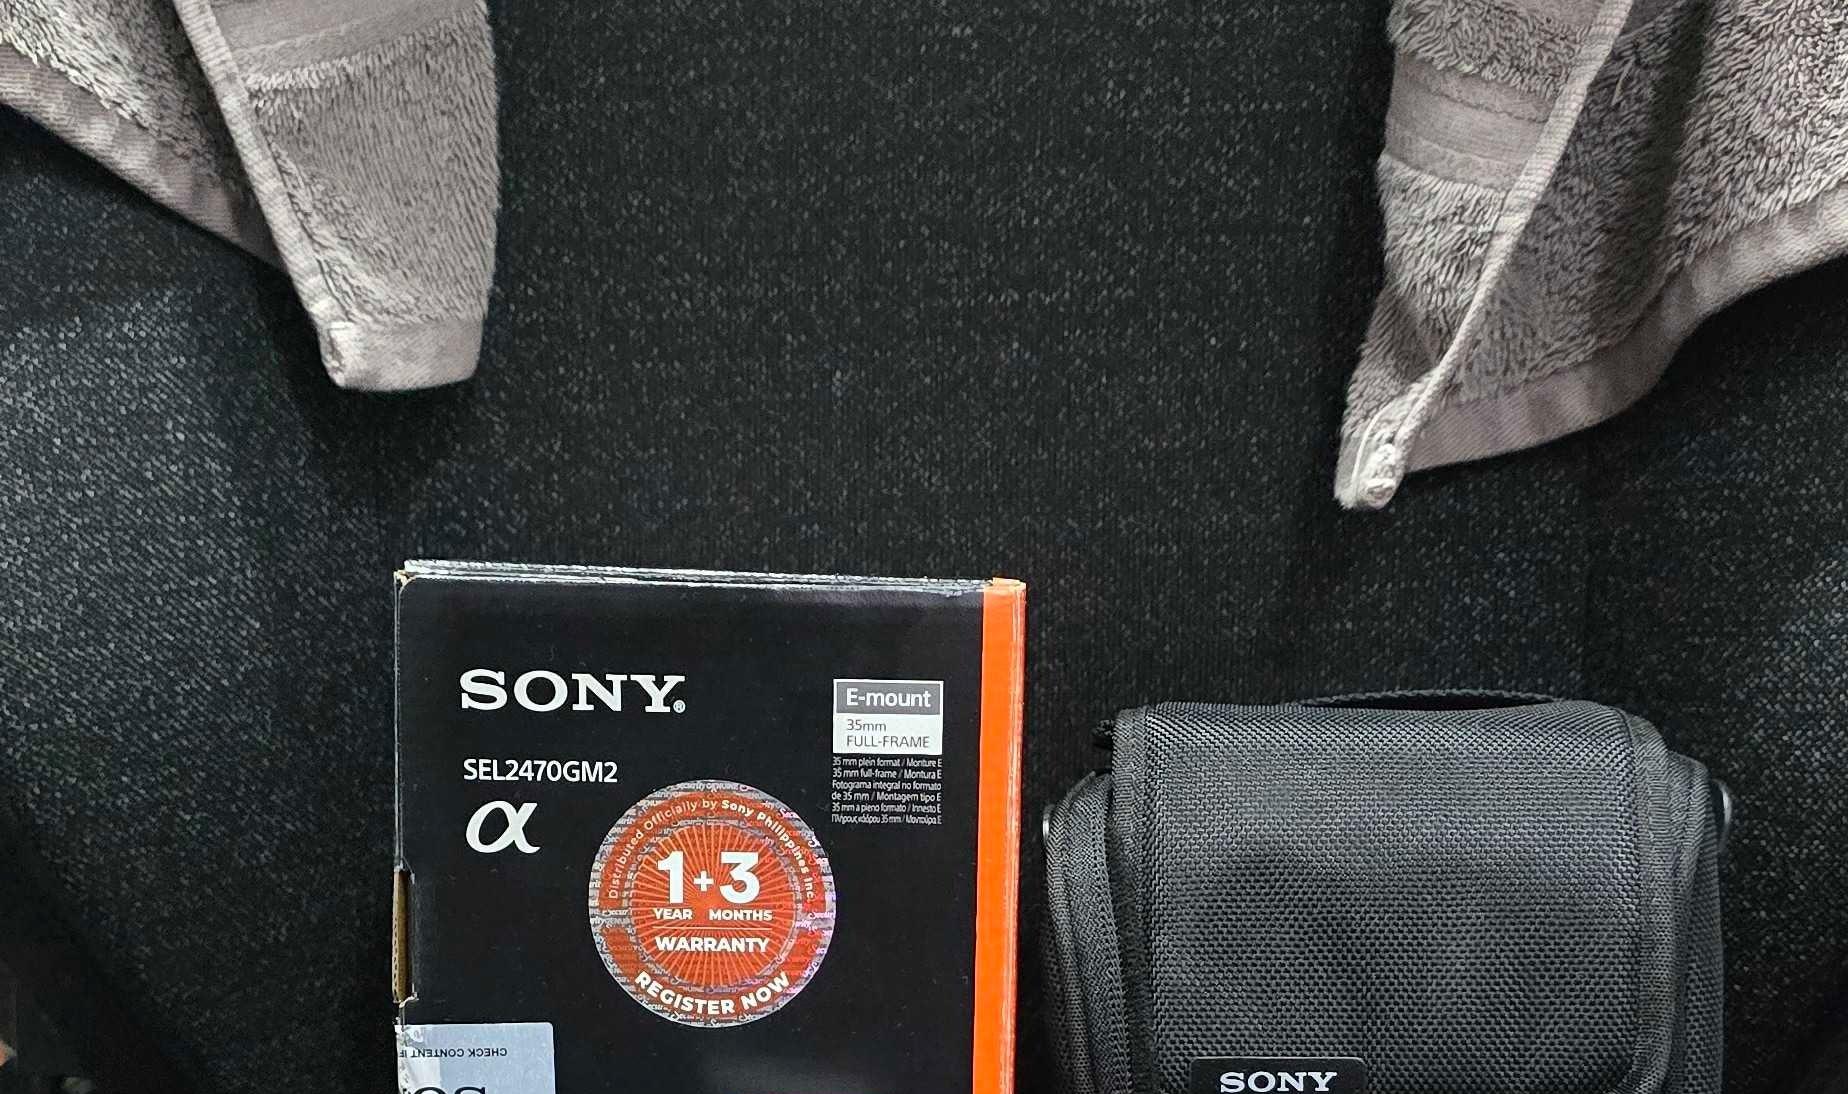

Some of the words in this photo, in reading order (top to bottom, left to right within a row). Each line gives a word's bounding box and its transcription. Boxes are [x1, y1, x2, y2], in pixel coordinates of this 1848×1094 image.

[846, 688, 931, 707] E-mount
[847, 719, 886, 731] 35mm
[846, 735, 930, 748] FULL-FRAME
[832, 757, 841, 766] 35
[842, 758, 857, 766] mm
[859, 757, 875, 769] plein
[876, 757, 900, 767] format
[907, 758, 936, 767] Monture
[463, 758, 618, 783] SEL2470GM2
[832, 768, 842, 778] 35
[843, 769, 859, 778] mm
[860, 768, 897, 778] full-frame
[904, 769, 936, 779] Montura
[832, 780, 871, 791] Fotograma
[872, 780, 901, 791] integral
[901, 782, 911, 790] no
[912, 781, 941, 790] formato
[832, 791, 841, 800] de
[842, 791, 852, 800] 35
[854, 792, 870, 801] mm
[877, 792, 918, 803] Montagem
[920, 793, 935, 803] tipo
[608, 831, 644, 900] Distributed
[643, 799, 699, 831] Officially
[702, 798, 717, 810] by
[721, 800, 754, 818] Sony
[756, 812, 810, 877] Philippines
[654, 908, 693, 920] YEAR
[709, 908, 773, 921] MONTHS
[655, 936, 770, 952] WARRANTY
[635, 971, 735, 1016] REGISTER
[740, 971, 791, 1011] NOW
[411, 1048, 465, 1058] CONTENT
[468, 1047, 507, 1058] CHECK
[1220, 1071, 1338, 1093] SONY
